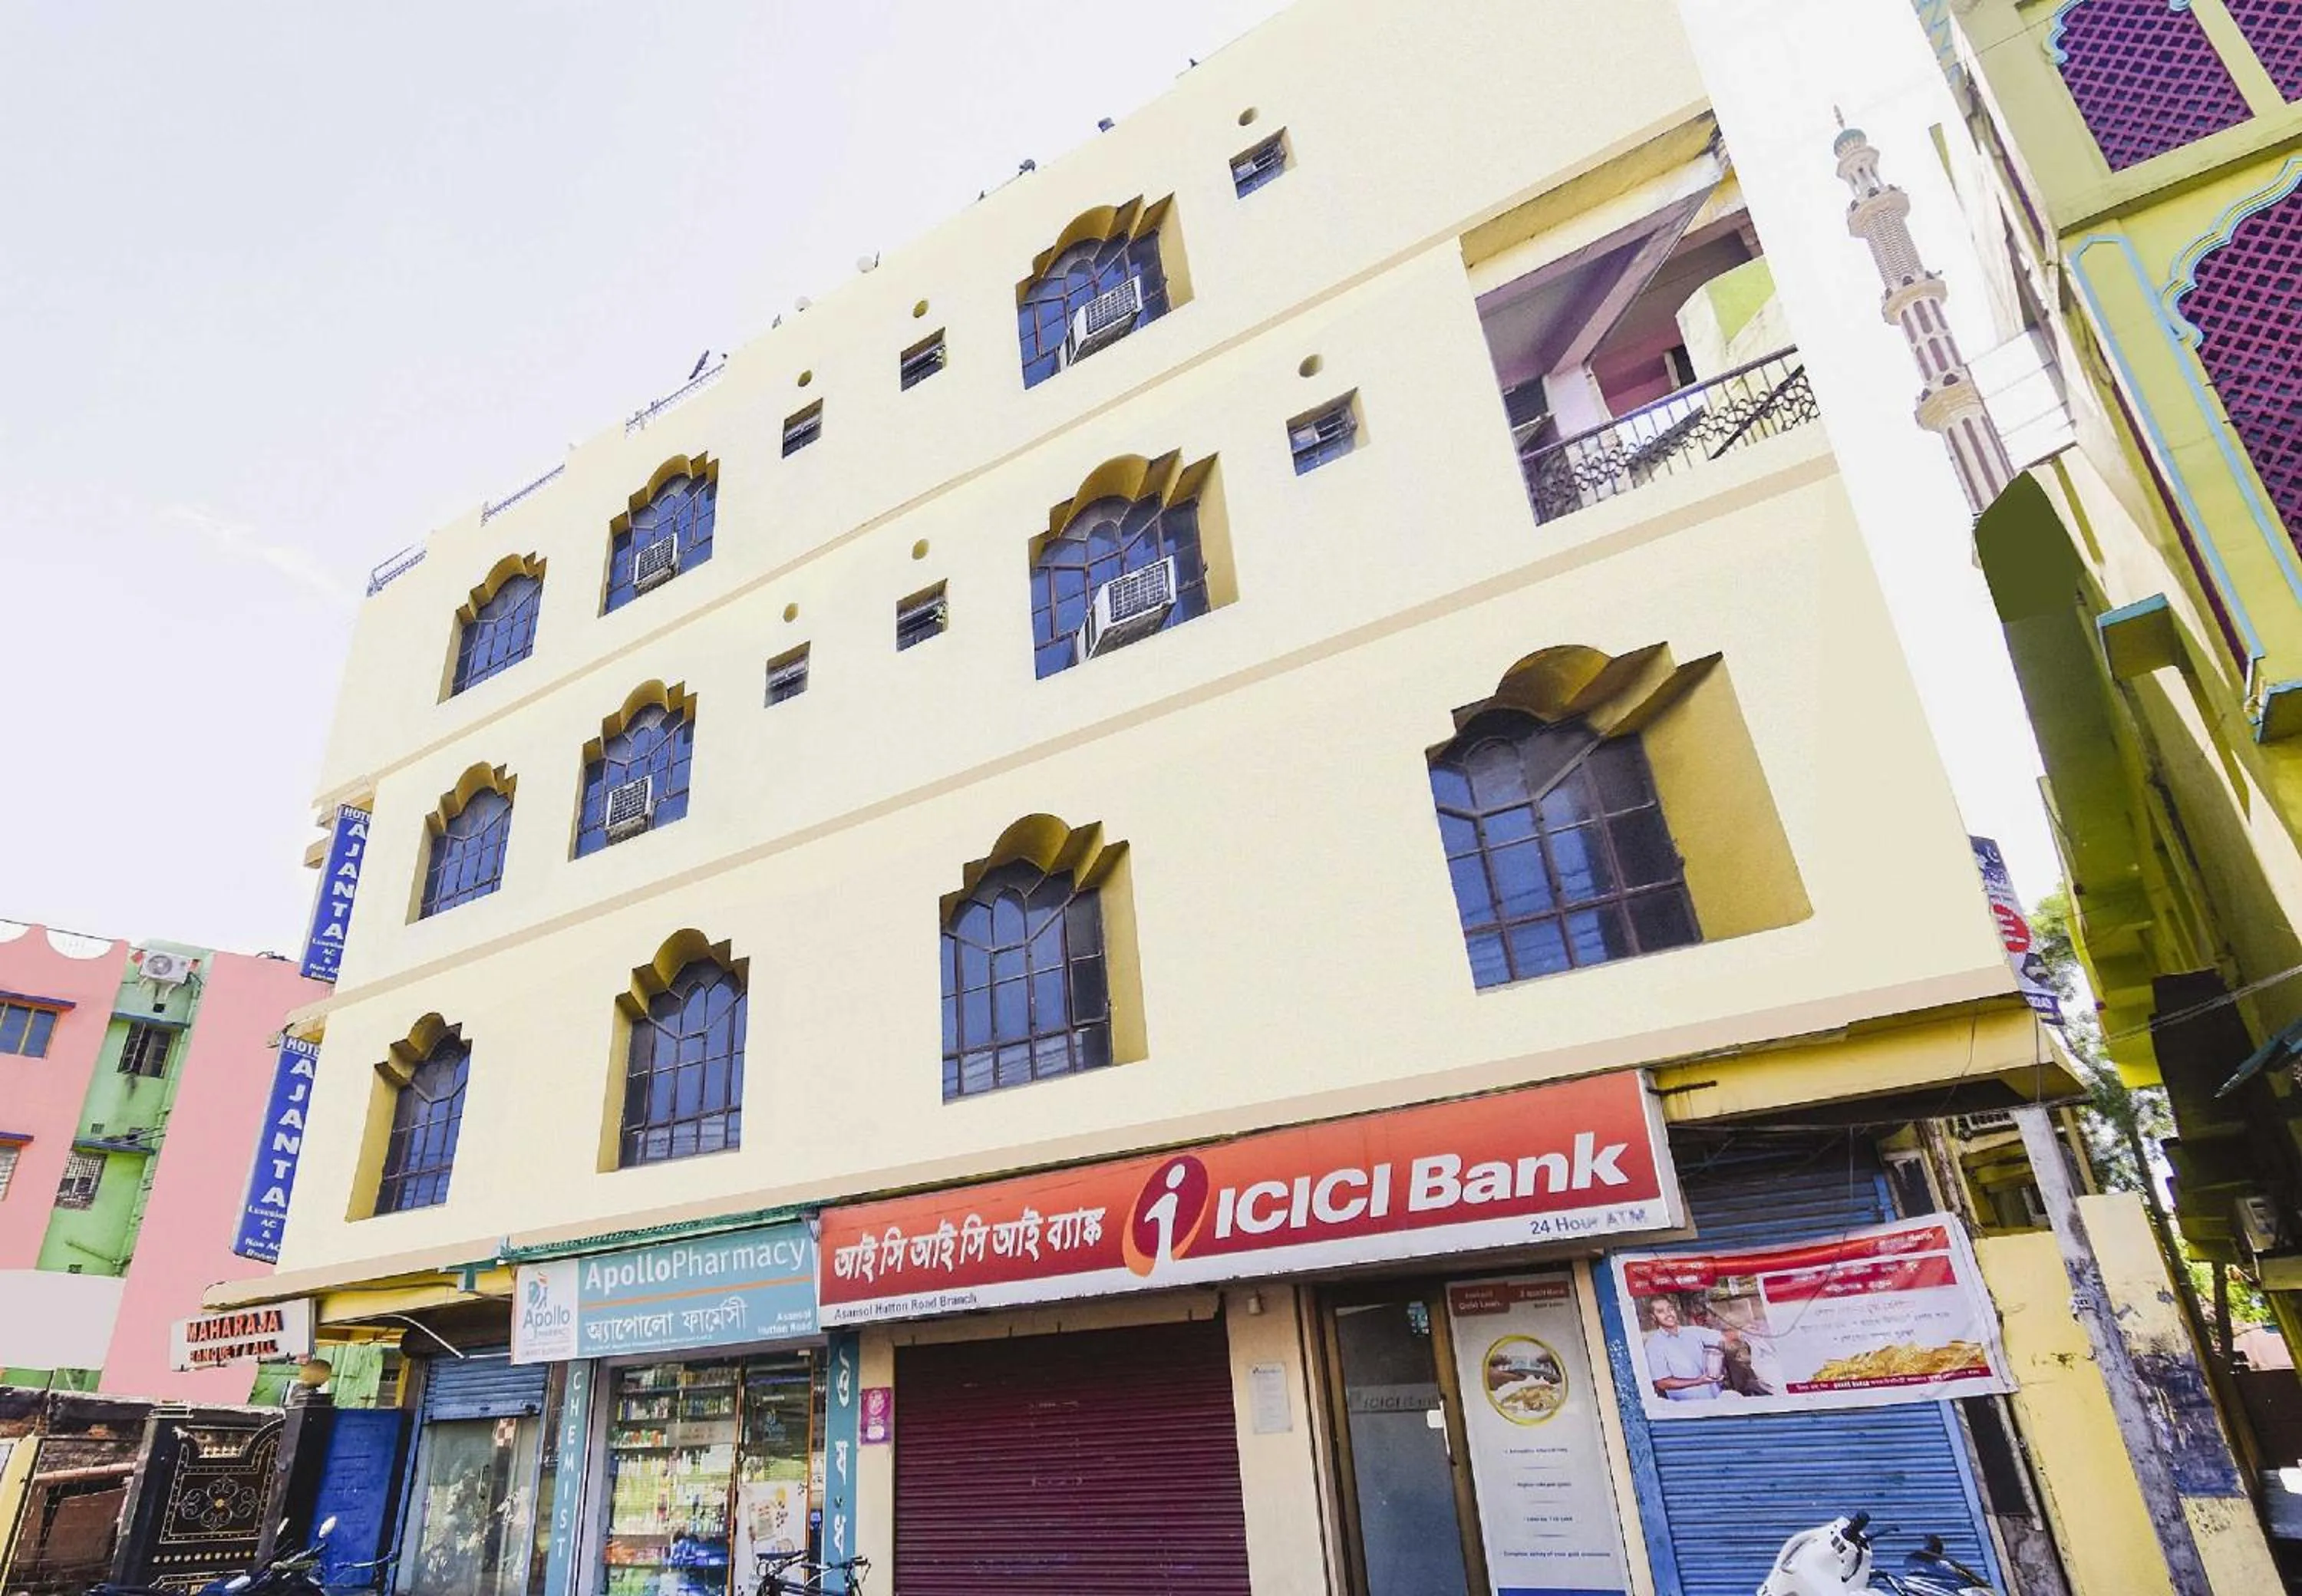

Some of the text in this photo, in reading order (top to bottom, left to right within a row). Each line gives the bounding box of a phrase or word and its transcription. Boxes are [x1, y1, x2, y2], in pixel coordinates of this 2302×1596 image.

[322, 823, 367, 940] AJANTA
[260, 1059, 314, 1208] AJANTA
[1214, 1162, 1391, 1239] ICICI
[1408, 1131, 1629, 1209] Bank
[1529, 1207, 1646, 1235] 24 Hour ATM
[834, 1231, 879, 1284] আই
[879, 1225, 909, 1276] সি
[910, 1218, 958, 1273] আই
[958, 1213, 991, 1265] সি
[992, 1205, 1044, 1262] আই
[186, 1310, 284, 1343] MAHARAJA
[523, 1304, 570, 1339] Apollo
[834, 1292, 977, 1321] Asansol Hutton Road Branch
[556, 1370, 582, 1559] CHEMIST
